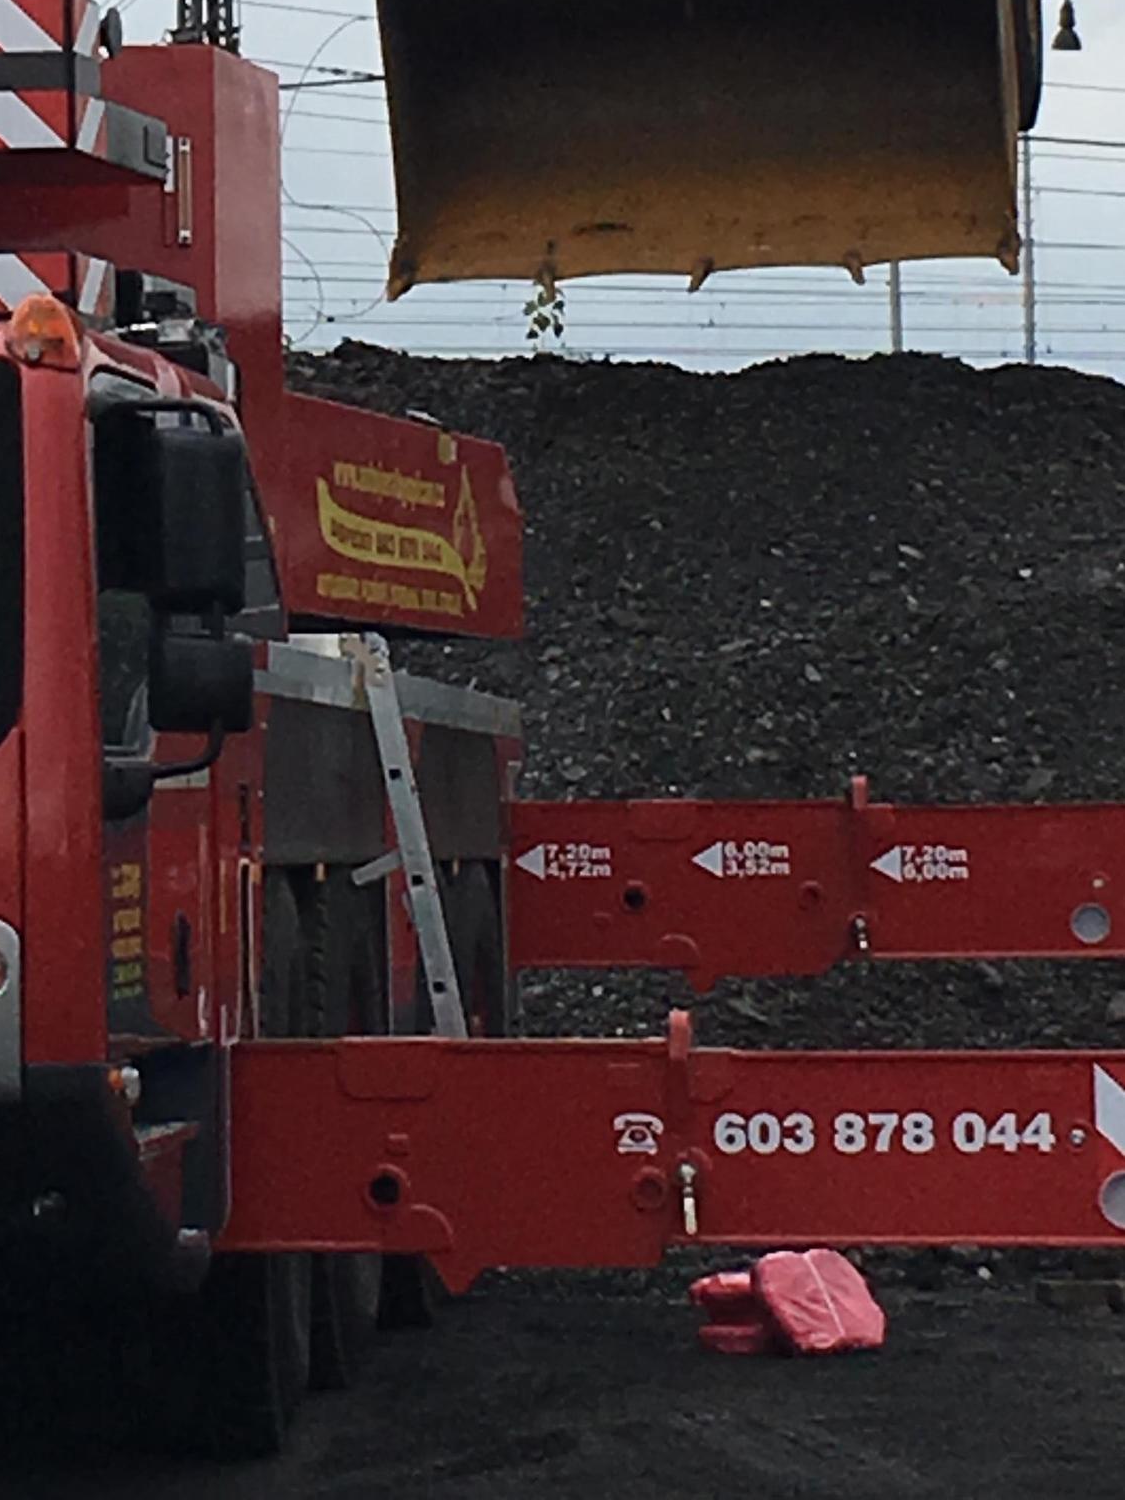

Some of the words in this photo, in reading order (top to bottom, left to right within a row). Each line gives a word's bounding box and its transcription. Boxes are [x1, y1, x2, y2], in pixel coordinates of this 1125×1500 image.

[902, 845, 968, 865] 7,20m
[713, 1112, 816, 1154] 603
[833, 1112, 936, 1153] 878
[953, 1112, 1057, 1153] 044
